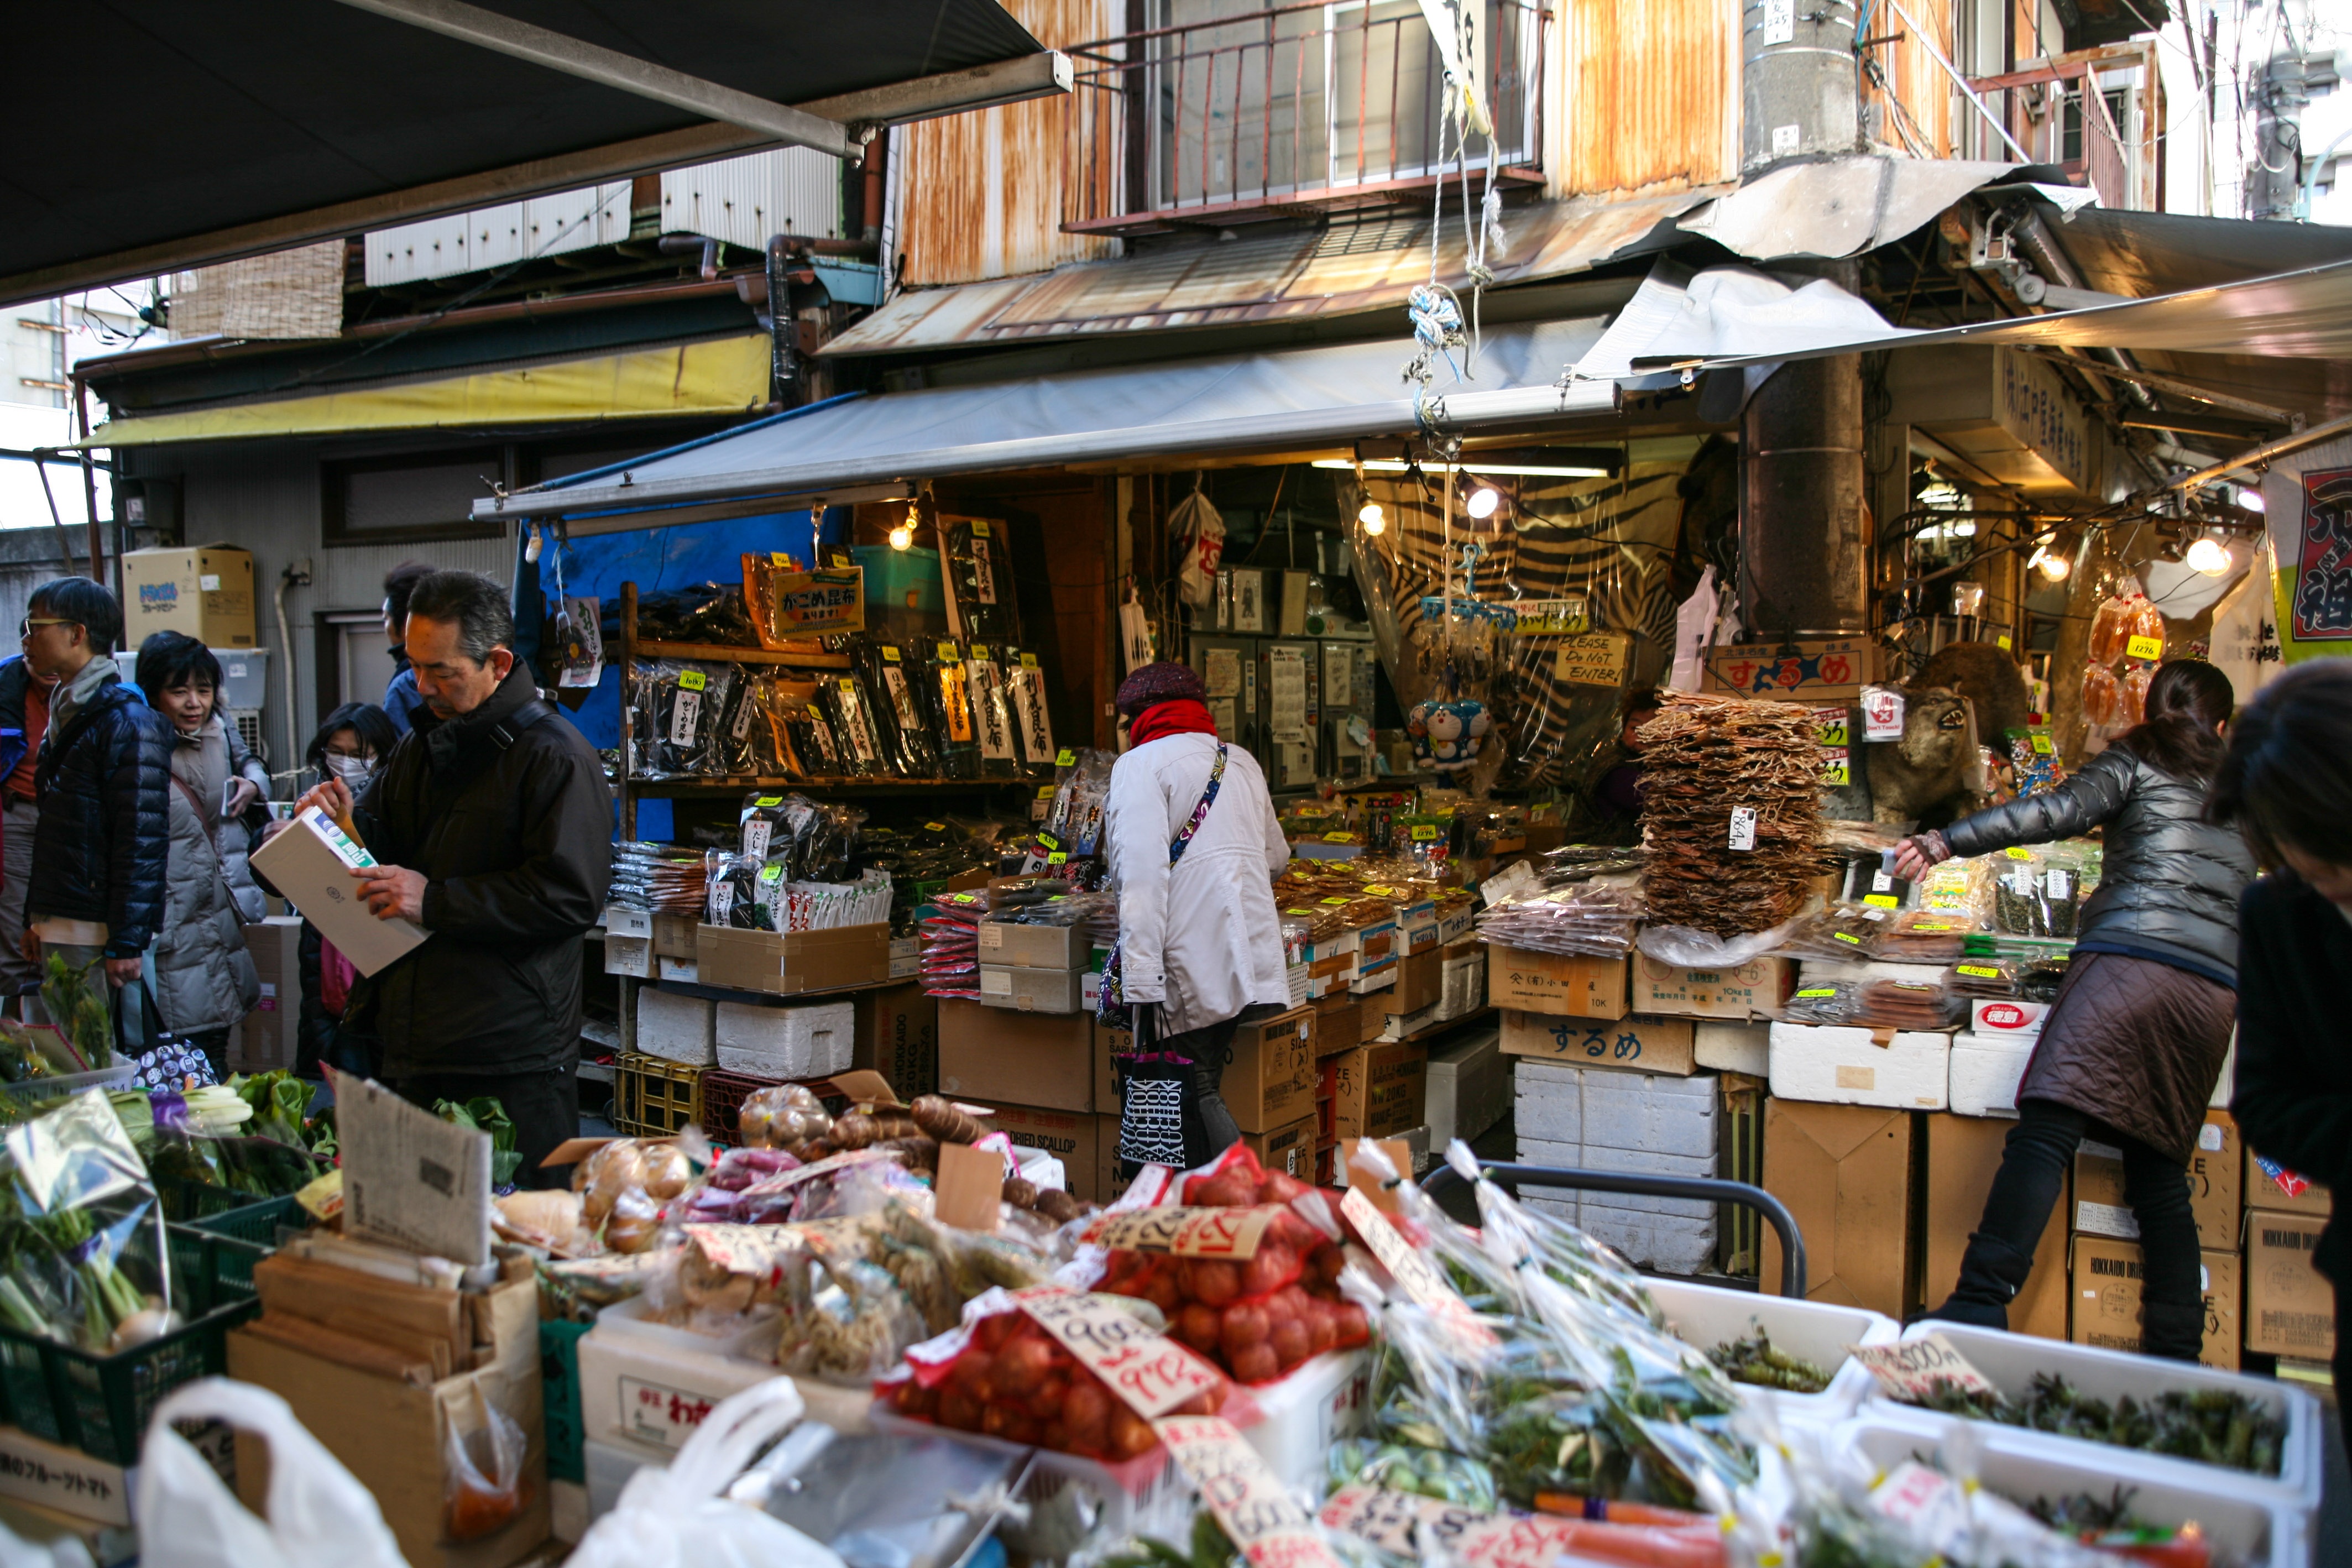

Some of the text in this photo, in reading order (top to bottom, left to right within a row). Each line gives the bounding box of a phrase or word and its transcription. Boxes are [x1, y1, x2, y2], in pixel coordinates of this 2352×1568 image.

[1767, 14, 1789, 28] 225
[782, 588, 856, 612] がごめ昆布
[803, 609, 839, 620] あります!
[1559, 636, 1609, 649] PLEASE
[2134, 644, 2155, 655] 1296
[1569, 666, 1624, 683] ENTER!
[1727, 654, 1851, 688] するめ
[685, 677, 702, 686] 1080
[976, 667, 1002, 754] 利尻昆布
[1023, 673, 1047, 757] 利尻昆布
[341, 842, 366, 864] 岡山
[1653, 992, 1686, 1001] 検査年月日
[1723, 987, 1742, 997] 10kg
[1987, 1011, 2019, 1023] 徳島
[1549, 1024, 1642, 1060] するめ
[1386, 1084, 1407, 1102] 20KG
[1010, 1130, 1076, 1154] DRIED SCALLOP
[2262, 1229, 2301, 1250] HOKKAIDO
[2090, 1256, 2125, 1278] HOKKAIDO
